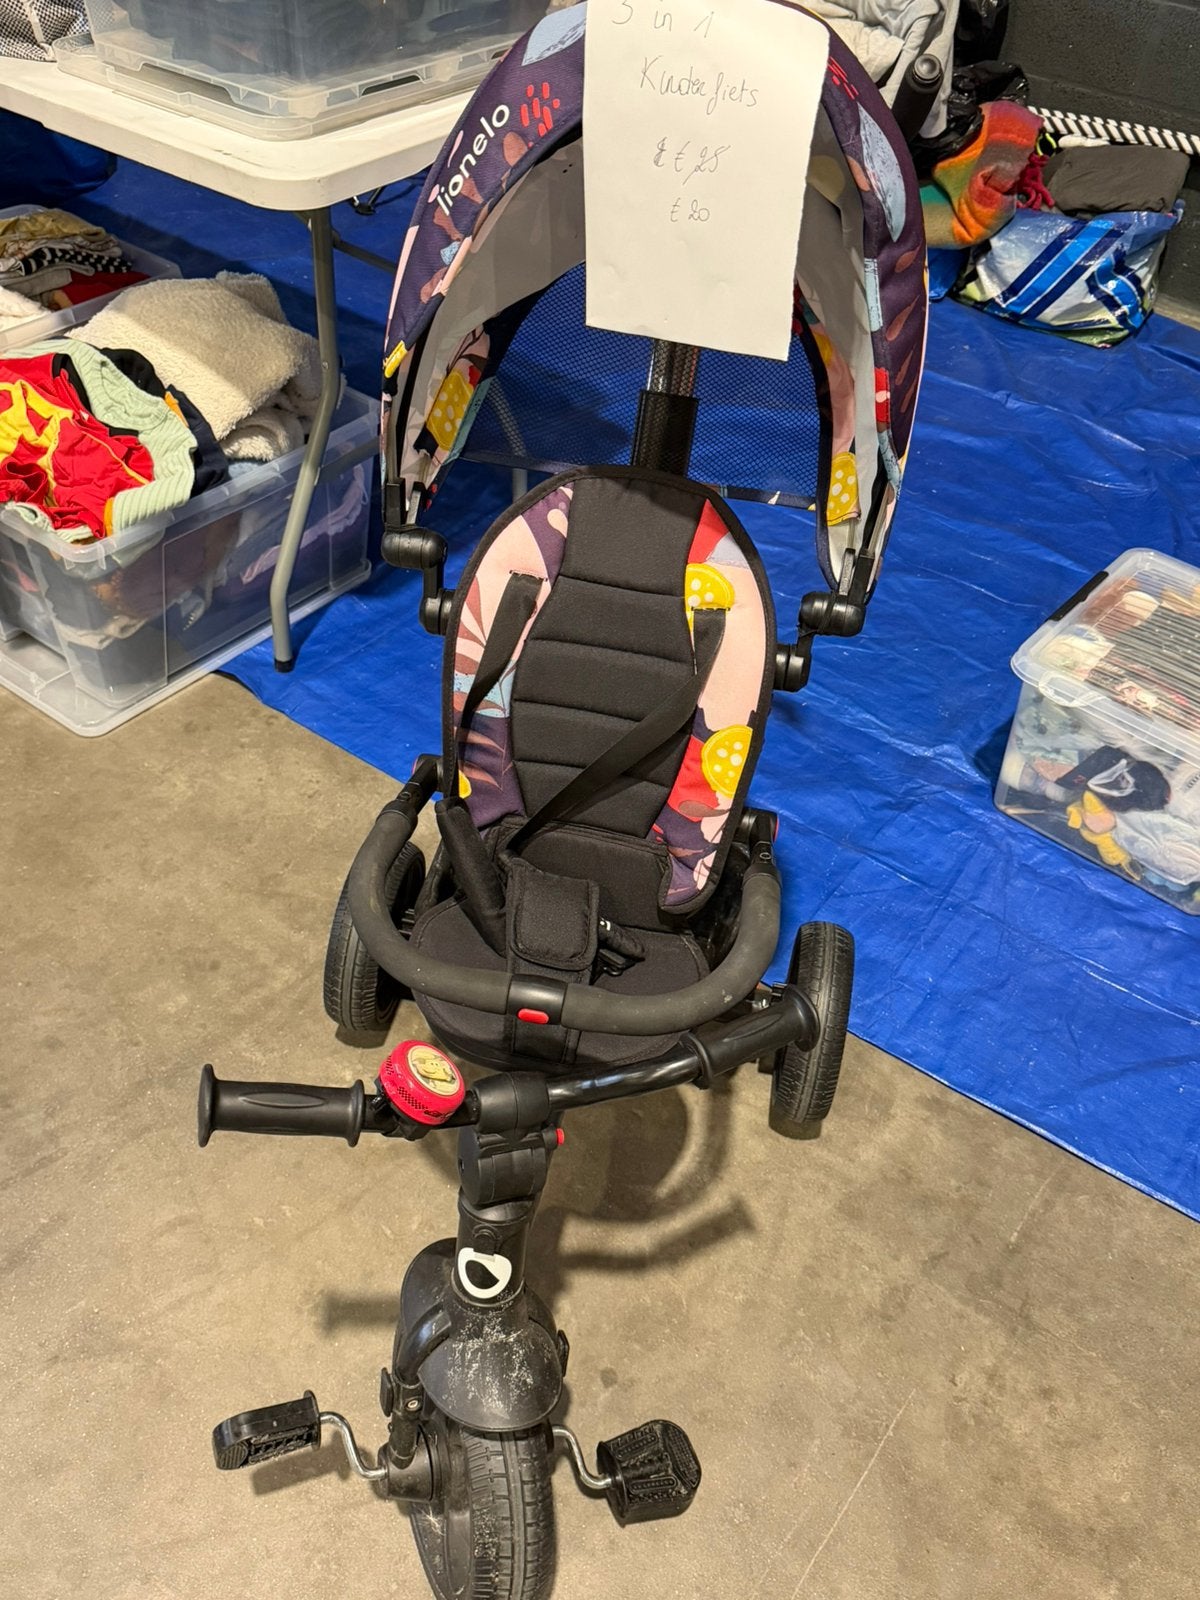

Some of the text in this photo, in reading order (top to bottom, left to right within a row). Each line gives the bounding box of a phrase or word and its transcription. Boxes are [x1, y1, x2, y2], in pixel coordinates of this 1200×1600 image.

[653, 0, 673, 32] in
[693, 11, 715, 39] 1
[639, 54, 759, 116] Kinderfiets
[436, 104, 510, 217] lionelo
[688, 199, 710, 222] 20
